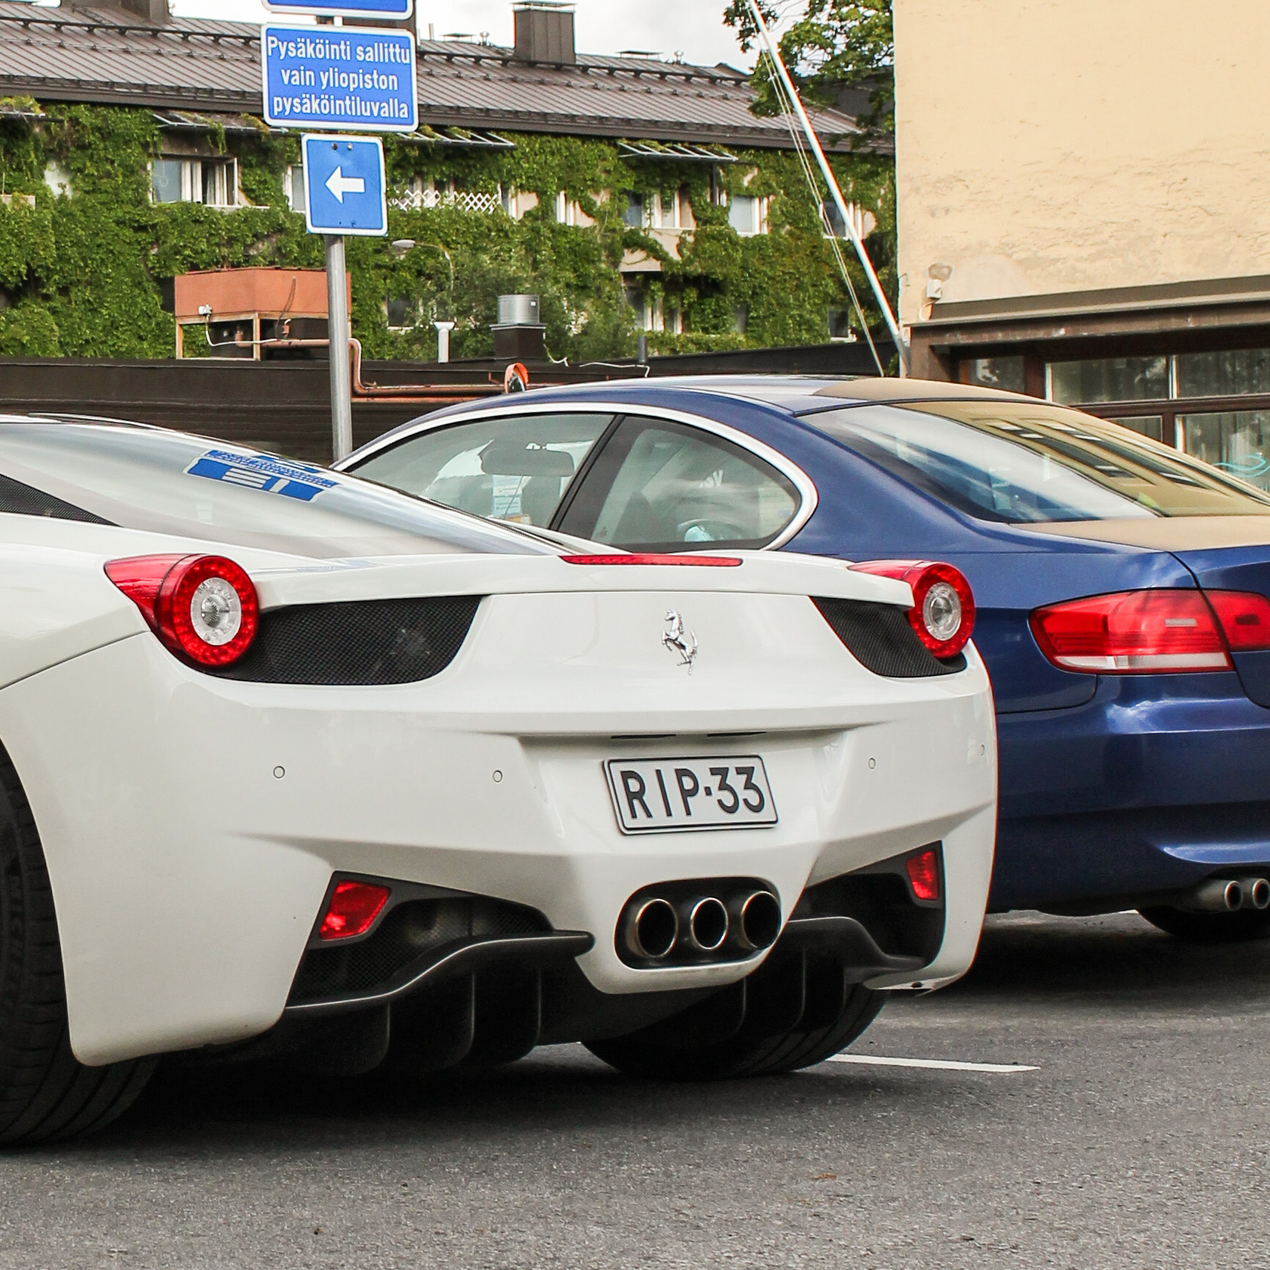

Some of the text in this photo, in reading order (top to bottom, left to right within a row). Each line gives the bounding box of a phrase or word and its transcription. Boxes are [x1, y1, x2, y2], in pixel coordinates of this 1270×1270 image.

[267, 36, 410, 64] Pysäköinti sallittu
[281, 66, 398, 92] vain yliopiston
[273, 93, 409, 119] pysäköintiluvalla
[620, 766, 765, 819] RIP-33
